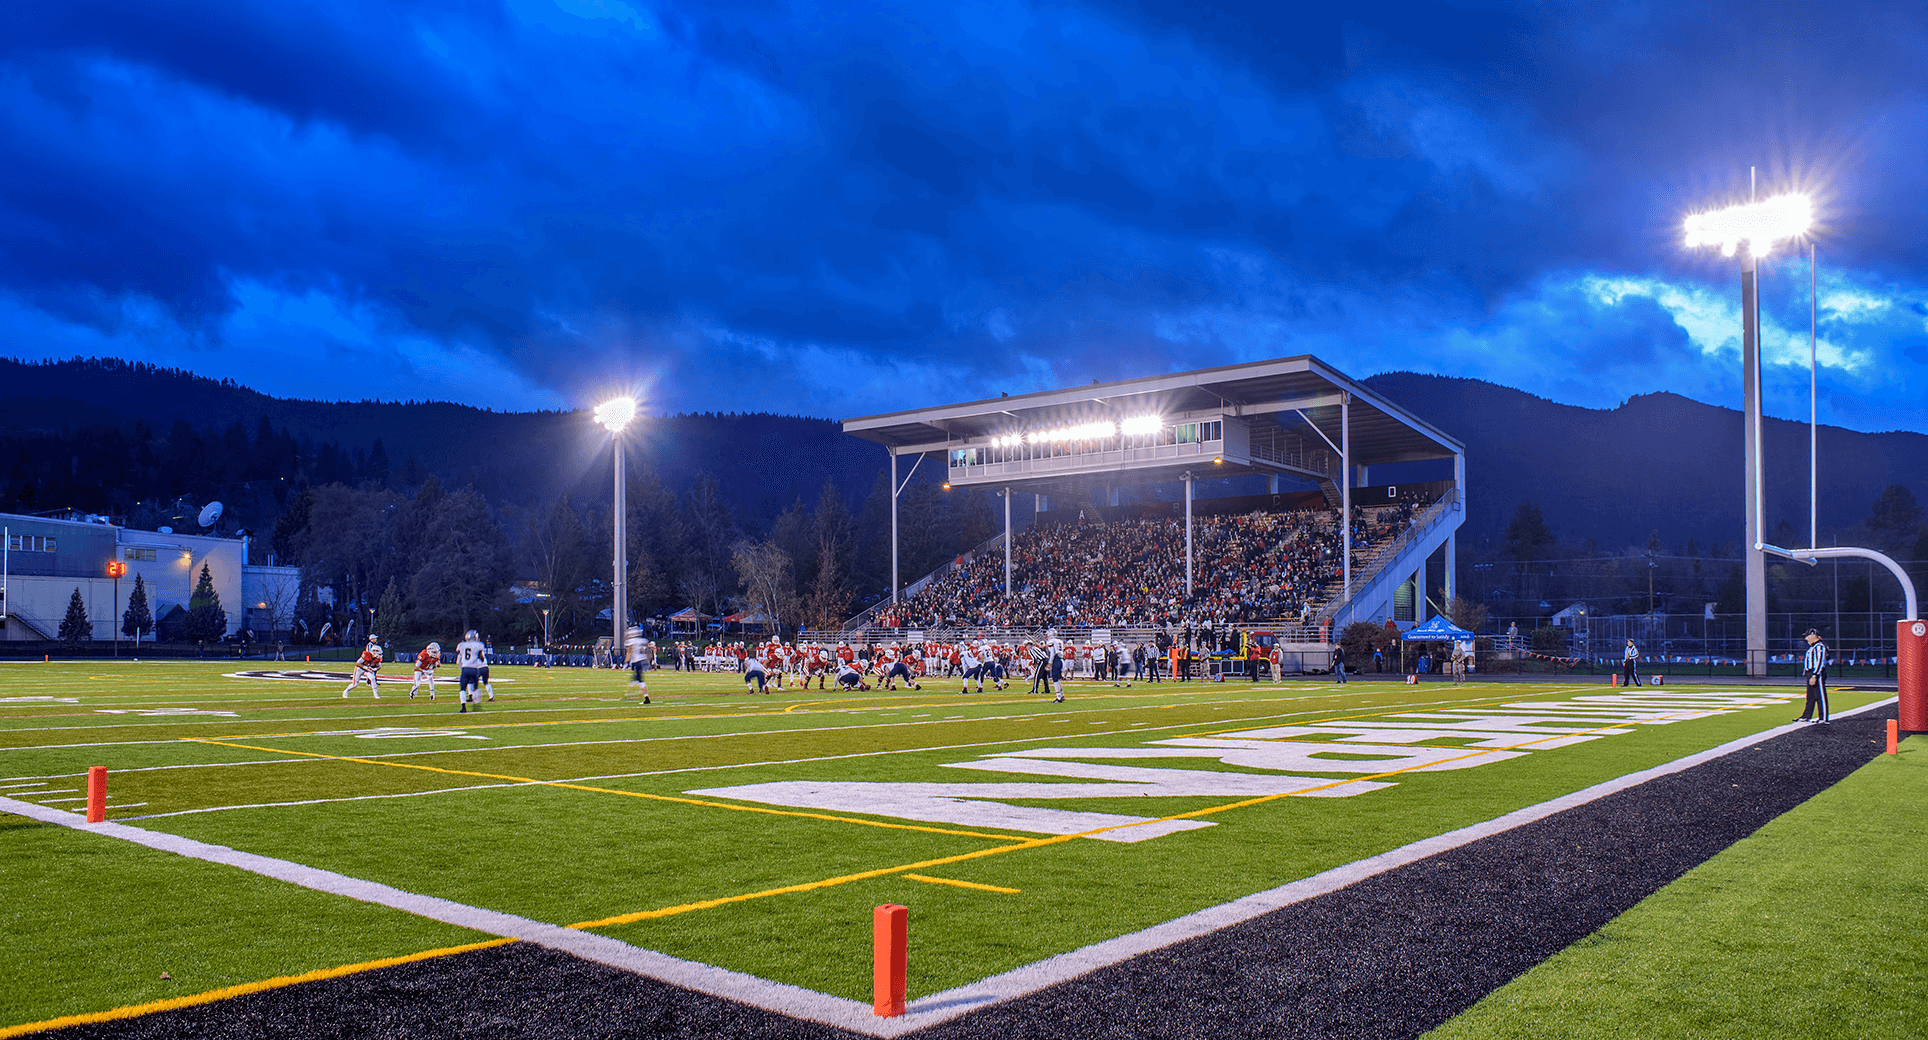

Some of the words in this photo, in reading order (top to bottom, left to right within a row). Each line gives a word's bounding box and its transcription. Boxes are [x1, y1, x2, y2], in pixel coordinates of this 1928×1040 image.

[1078, 509, 1086, 520] A
[109, 562, 125, 574] 21
[465, 648, 472, 660] 6
[1406, 675, 1416, 684] 10
[1651, 676, 1661, 685] G
